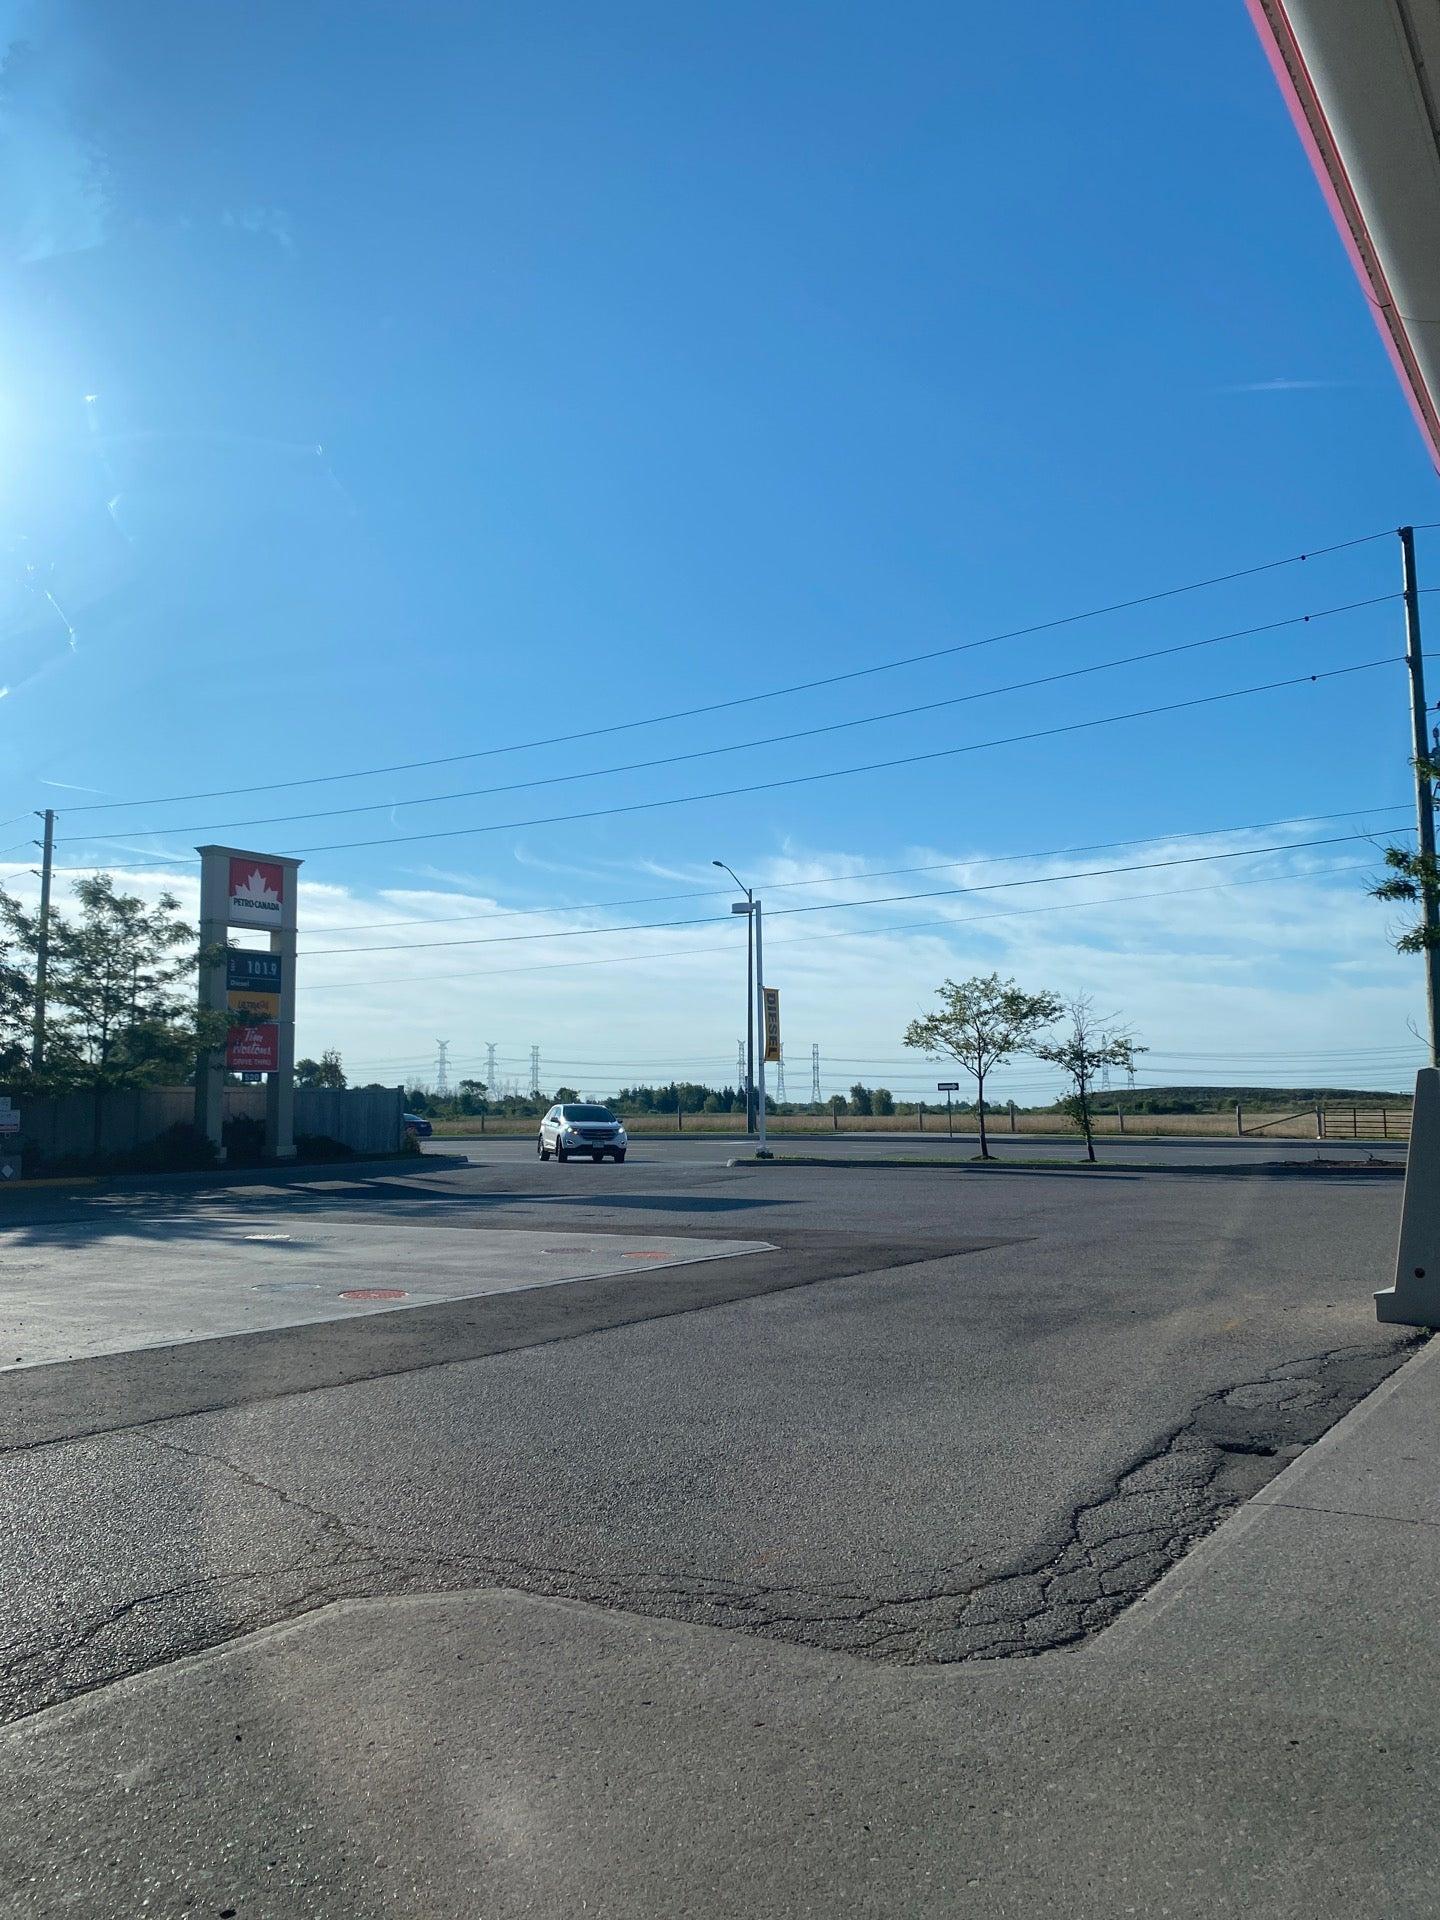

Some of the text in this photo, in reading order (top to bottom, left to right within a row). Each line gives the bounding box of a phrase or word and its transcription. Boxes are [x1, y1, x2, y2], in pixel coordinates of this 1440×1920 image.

[766, 992, 778, 1058] DIESEL
[244, 1027, 264, 1042] Tim
[232, 1041, 272, 1056] Hortons
